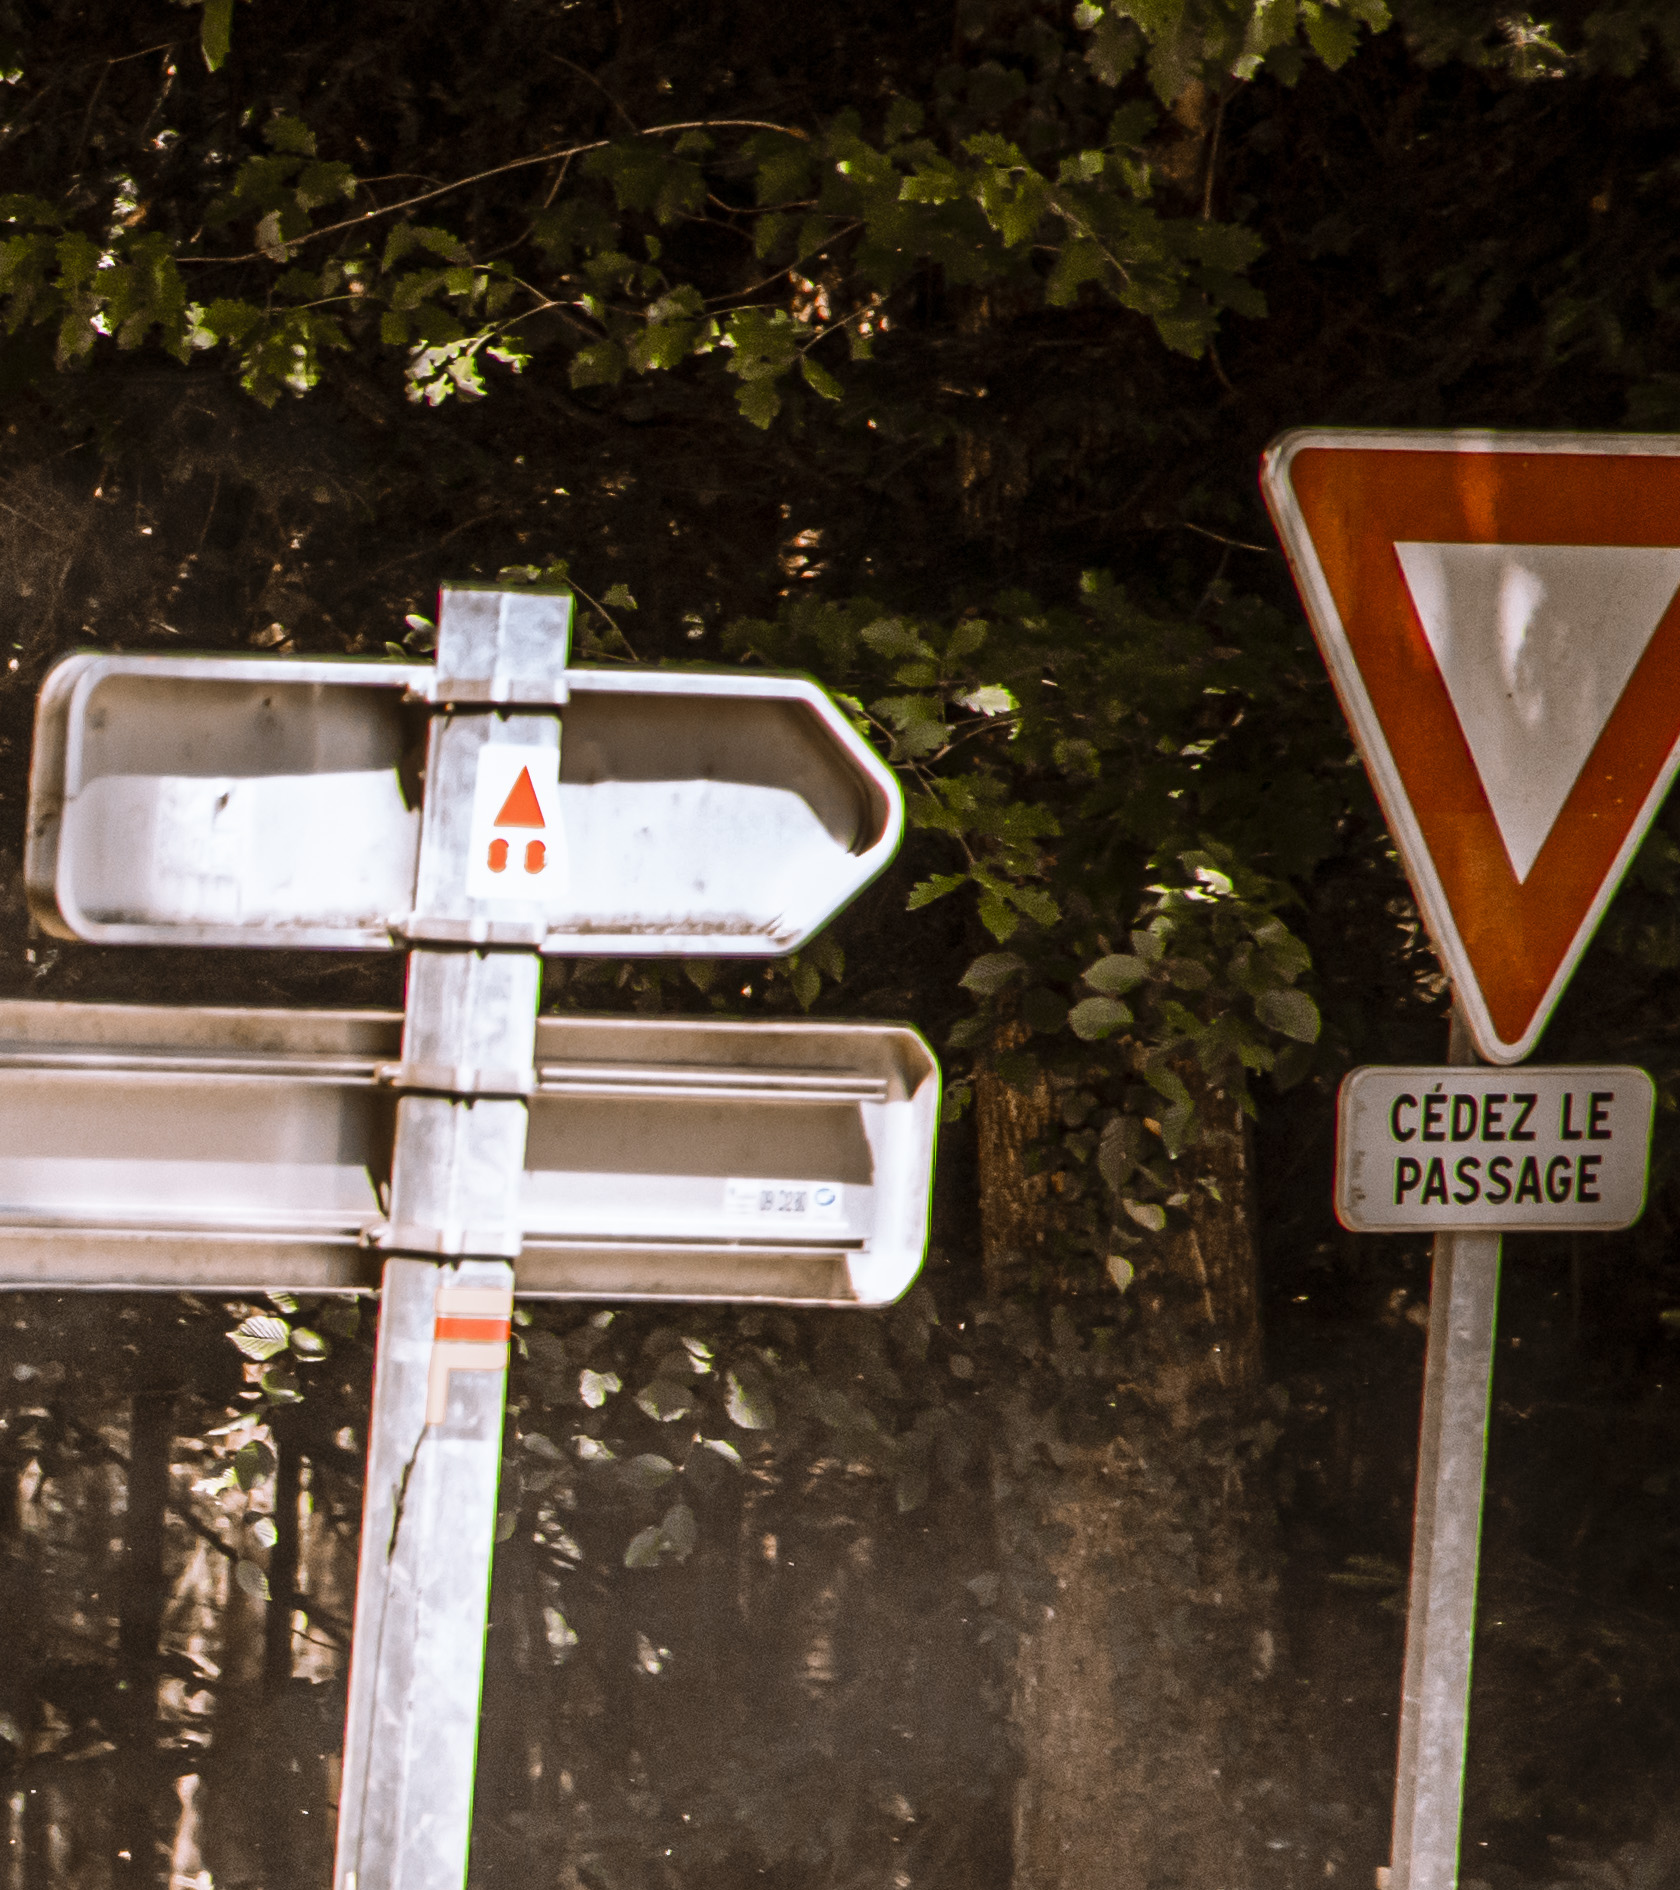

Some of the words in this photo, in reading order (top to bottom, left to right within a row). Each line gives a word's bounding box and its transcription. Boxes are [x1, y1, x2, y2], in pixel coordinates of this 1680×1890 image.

[1388, 1082, 1539, 1143] CÉDEZ
[1558, 1091, 1615, 1141] LE
[1392, 1154, 1603, 1206] PASSAGE
